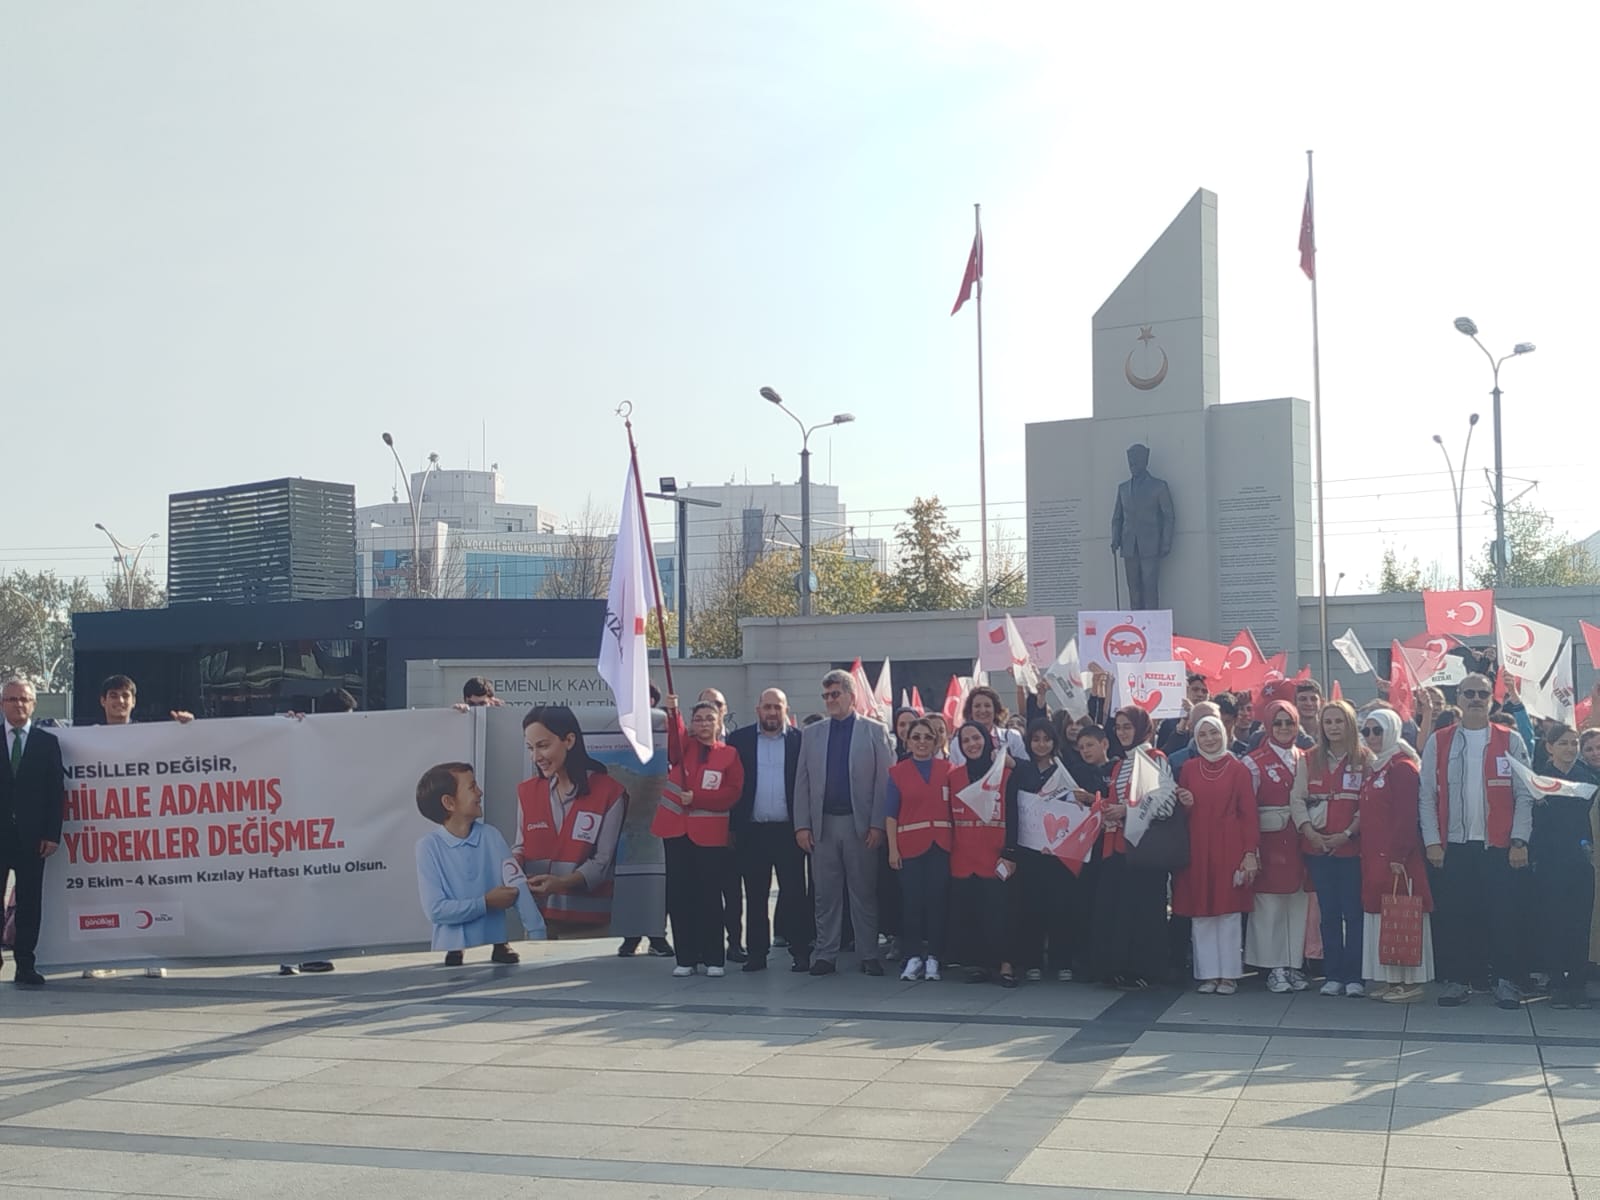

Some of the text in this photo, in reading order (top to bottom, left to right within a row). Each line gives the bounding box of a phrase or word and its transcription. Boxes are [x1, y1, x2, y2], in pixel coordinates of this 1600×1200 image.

[1144, 673, 1176, 681] KIZILAY
[156, 755, 237, 774] DEĞİŞİR,
[64, 778, 282, 821] HİLALE ADANMIŞ
[64, 816, 345, 864] YÜREKLER DEĞİŞMEZ.
[66, 878, 84, 889] 29
[148, 873, 192, 886] Kasım
[196, 870, 245, 882] Kızılay
[249, 866, 300, 880] Haftası
[303, 863, 341, 876] Kutlu
[344, 860, 387, 873] Olsun.
